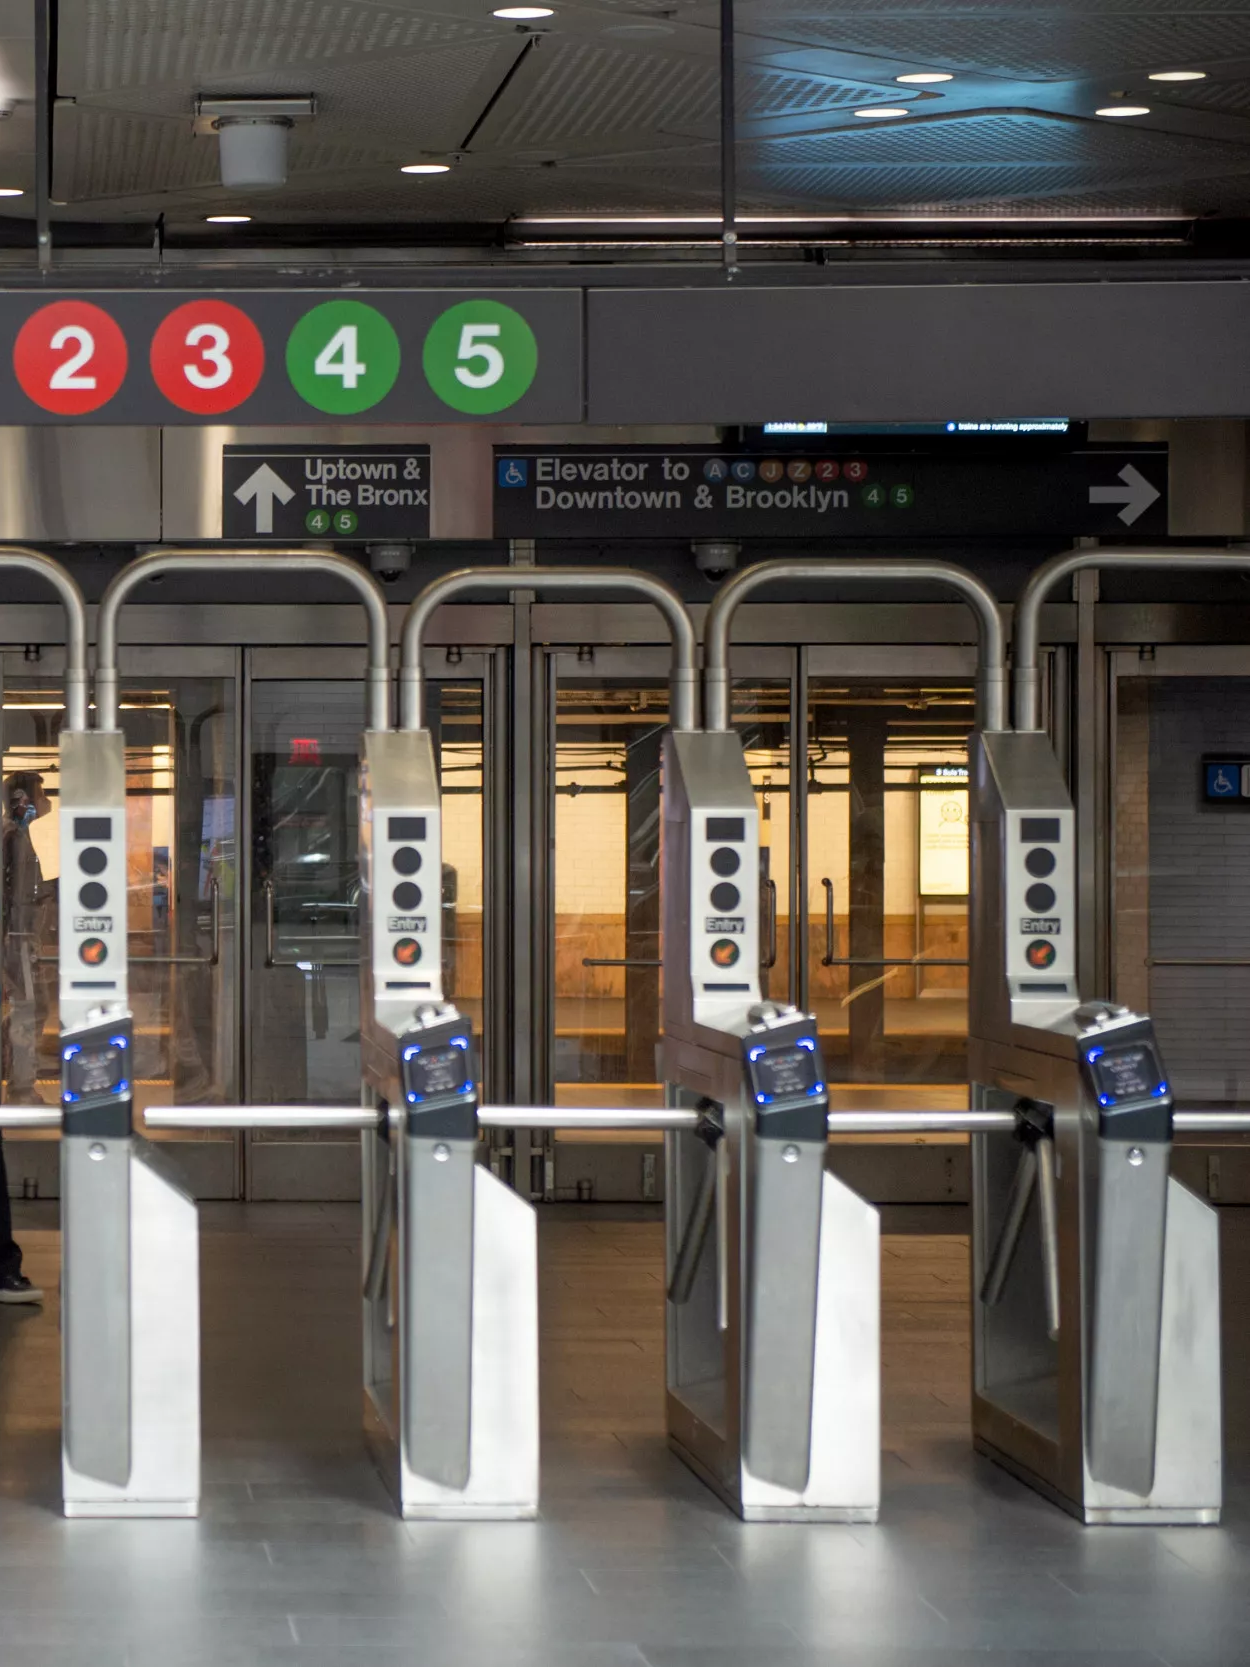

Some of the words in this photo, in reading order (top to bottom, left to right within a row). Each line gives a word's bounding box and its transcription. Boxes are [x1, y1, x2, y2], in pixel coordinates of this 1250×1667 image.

[49, 325, 97, 390] 2
[183, 323, 233, 389] 3
[314, 325, 366, 389] 4
[453, 324, 506, 389] 5
[958, 422, 979, 430] trains
[992, 422, 1018, 432] running
[1019, 422, 1068, 432] approximately
[305, 458, 397, 483] Uptown
[403, 458, 421, 480] &
[536, 458, 649, 481] Elevator
[662, 458, 690, 481] to
[709, 464, 722, 478] A
[736, 464, 749, 478] C
[766, 463, 776, 478] J
[794, 464, 806, 478] Z
[822, 463, 834, 478] 2
[850, 462, 862, 478] 3
[305, 485, 351, 506] The
[357, 485, 429, 506] Bronx
[536, 486, 681, 509] Downtown
[693, 485, 713, 509] &
[726, 486, 849, 512] Brooklyn
[867, 489, 879, 503] 4
[896, 489, 907, 503] 5
[311, 515, 323, 529] 4
[340, 515, 351, 529] 5
[74, 917, 112, 932] Entry
[388, 917, 427, 932] Entry
[706, 918, 744, 933] Entry
[1021, 919, 1060, 934] Entry
